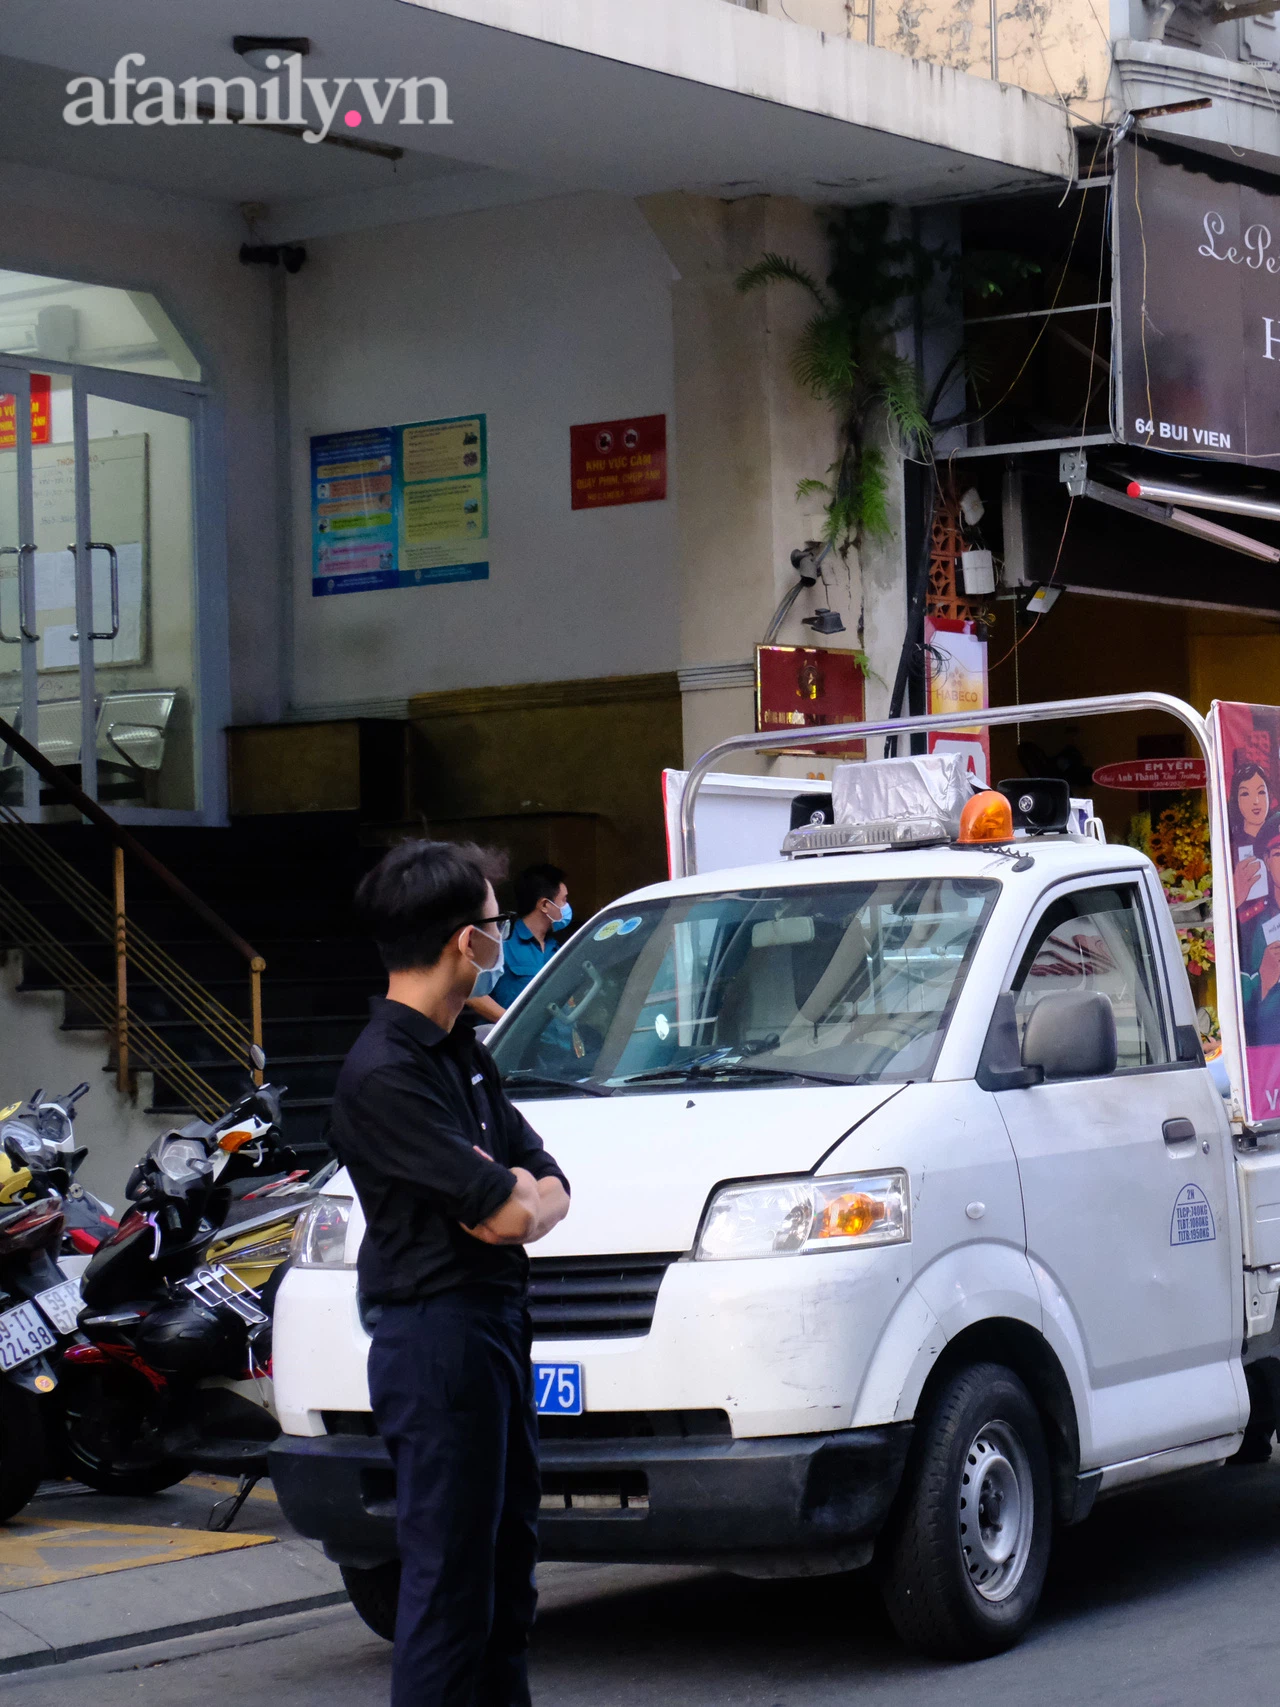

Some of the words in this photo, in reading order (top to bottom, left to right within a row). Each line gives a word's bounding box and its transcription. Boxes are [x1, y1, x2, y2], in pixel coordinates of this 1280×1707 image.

[1198, 211, 1244, 264] Le
[1135, 418, 1154, 435] 64
[1160, 422, 1188, 441] BUI
[1192, 428, 1230, 448] VIEN
[936, 688, 978, 703] HABECO
[1144, 763, 1163, 771] EM
[0, 1308, 34, 1341] 9-T1
